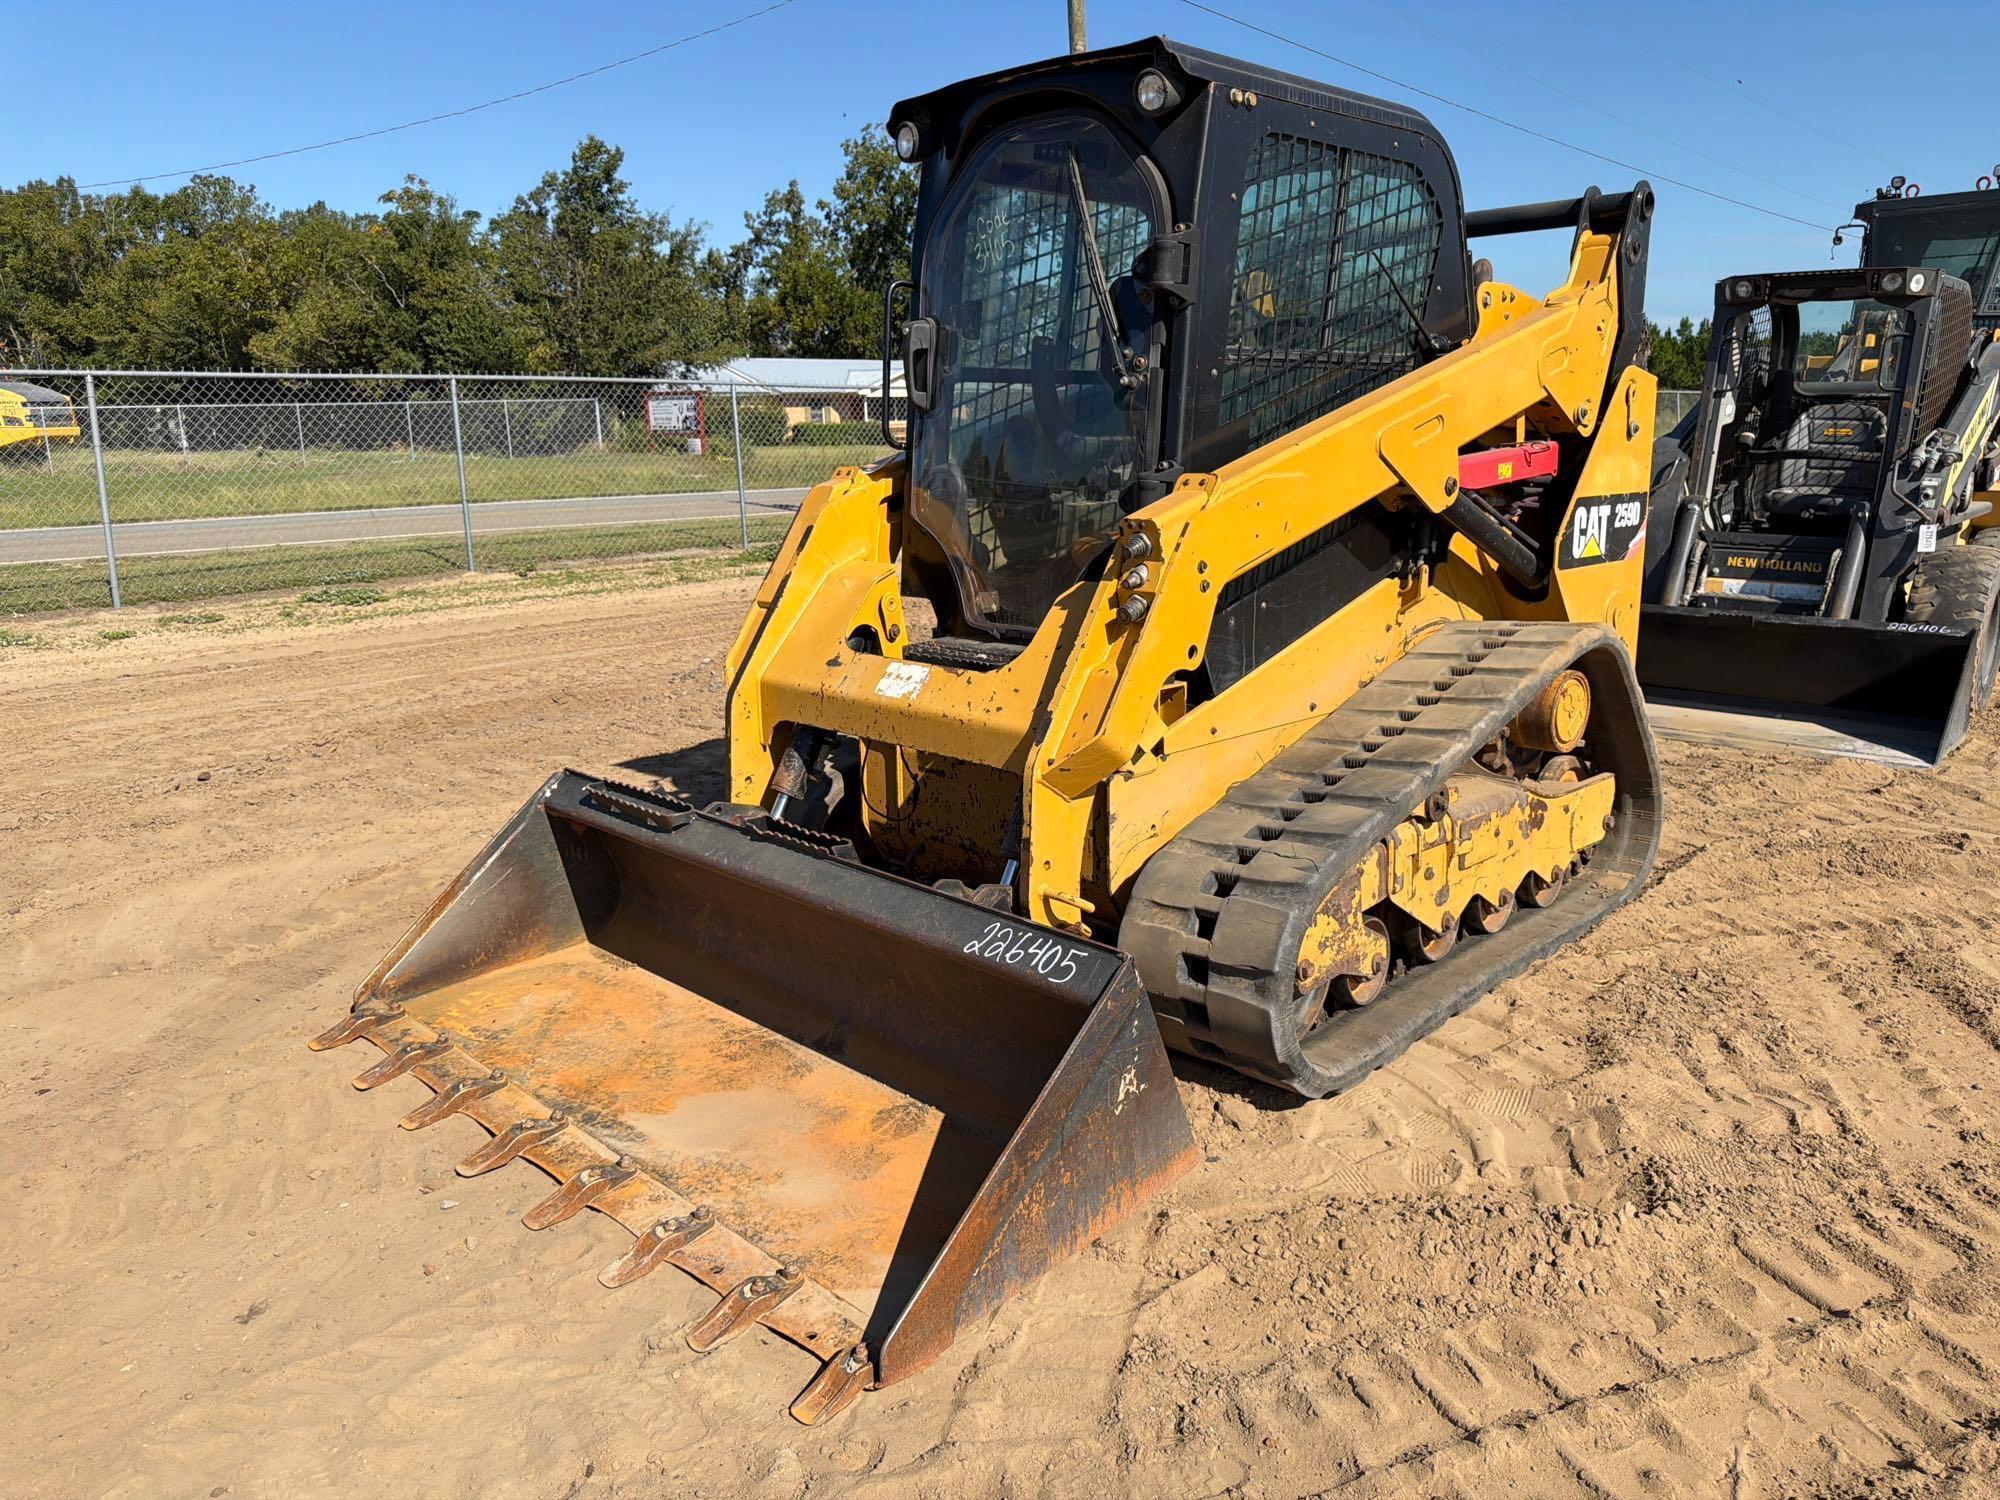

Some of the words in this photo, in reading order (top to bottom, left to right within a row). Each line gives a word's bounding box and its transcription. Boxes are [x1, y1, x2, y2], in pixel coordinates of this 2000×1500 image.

[976, 206, 1010, 239] Code
[974, 229, 1015, 273] 3405
[1572, 505, 1611, 559] CAT
[1614, 502, 1640, 528] 259D
[1727, 556, 1758, 568] NEW
[1760, 558, 1822, 573] HOLLAND
[1886, 622, 1951, 634] 226406
[963, 922, 1089, 983] 226405
